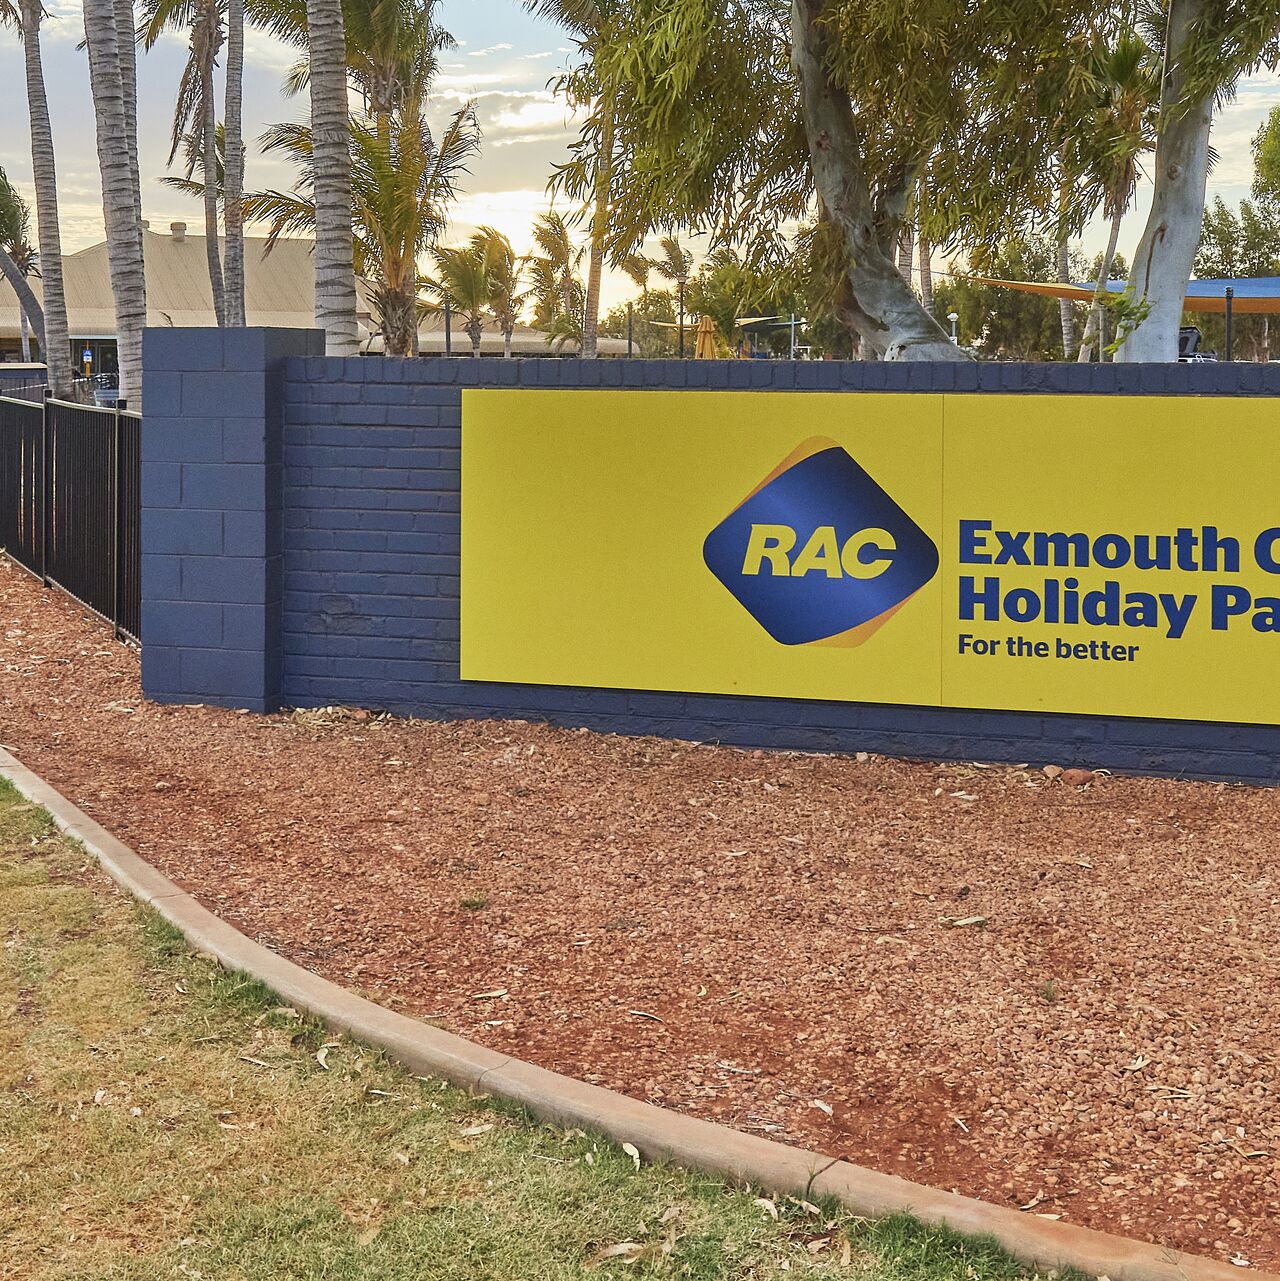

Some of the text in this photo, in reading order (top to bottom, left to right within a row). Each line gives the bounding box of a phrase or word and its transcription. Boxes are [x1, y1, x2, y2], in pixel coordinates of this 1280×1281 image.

[742, 523, 897, 580] RAC
[959, 519, 1240, 573] Exmouth
[958, 575, 1198, 639] Holiday
[958, 633, 1139, 662] For the better
